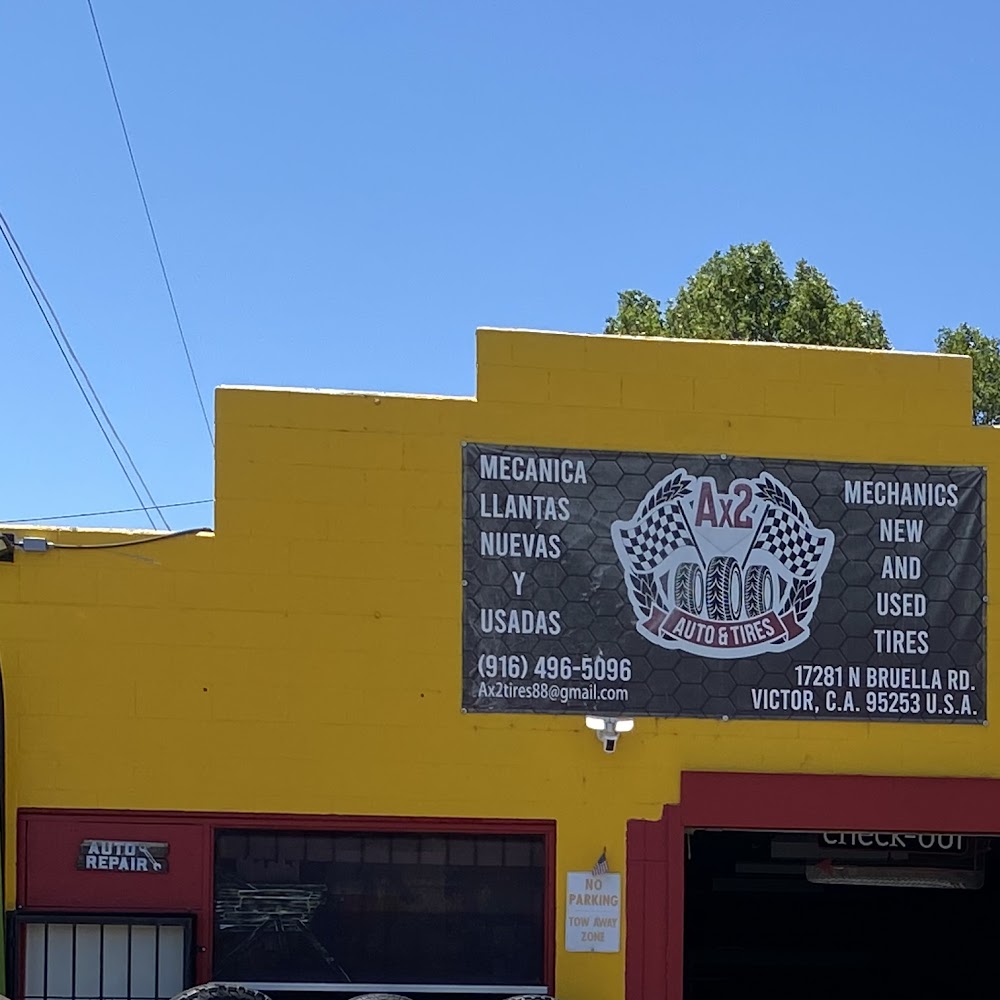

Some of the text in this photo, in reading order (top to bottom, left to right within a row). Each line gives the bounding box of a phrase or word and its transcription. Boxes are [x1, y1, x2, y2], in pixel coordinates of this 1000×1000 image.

[480, 454, 587, 484] MECANICA
[694, 481, 753, 529] Ax2
[844, 480, 958, 507] MECHANICS
[481, 493, 570, 521] LLANTAS
[879, 518, 923, 543] NEW
[480, 532, 561, 559] NUEVAS
[881, 555, 921, 580] AND
[512, 571, 525, 596] Y
[876, 592, 926, 617] USED
[480, 608, 561, 635] USADAS
[673, 618, 775, 646] AUTO & TIRES
[874, 629, 929, 655] TIRES
[478, 654, 632, 681] (916) 496-5096
[794, 665, 976, 691] 17281 N BRUELLA RD.
[478, 682, 629, 703] Ax2tires88@gmail.com
[751, 688, 978, 716] VICTOR, C.A. 95253 U.S.A.
[88, 841, 136, 856] AUTO
[85, 855, 149, 871] REPAIR
[584, 878, 603, 891] NO
[569, 893, 619, 906] PARKING
[568, 916, 618, 928] TOW AWAY
[581, 931, 605, 942] ZONE
